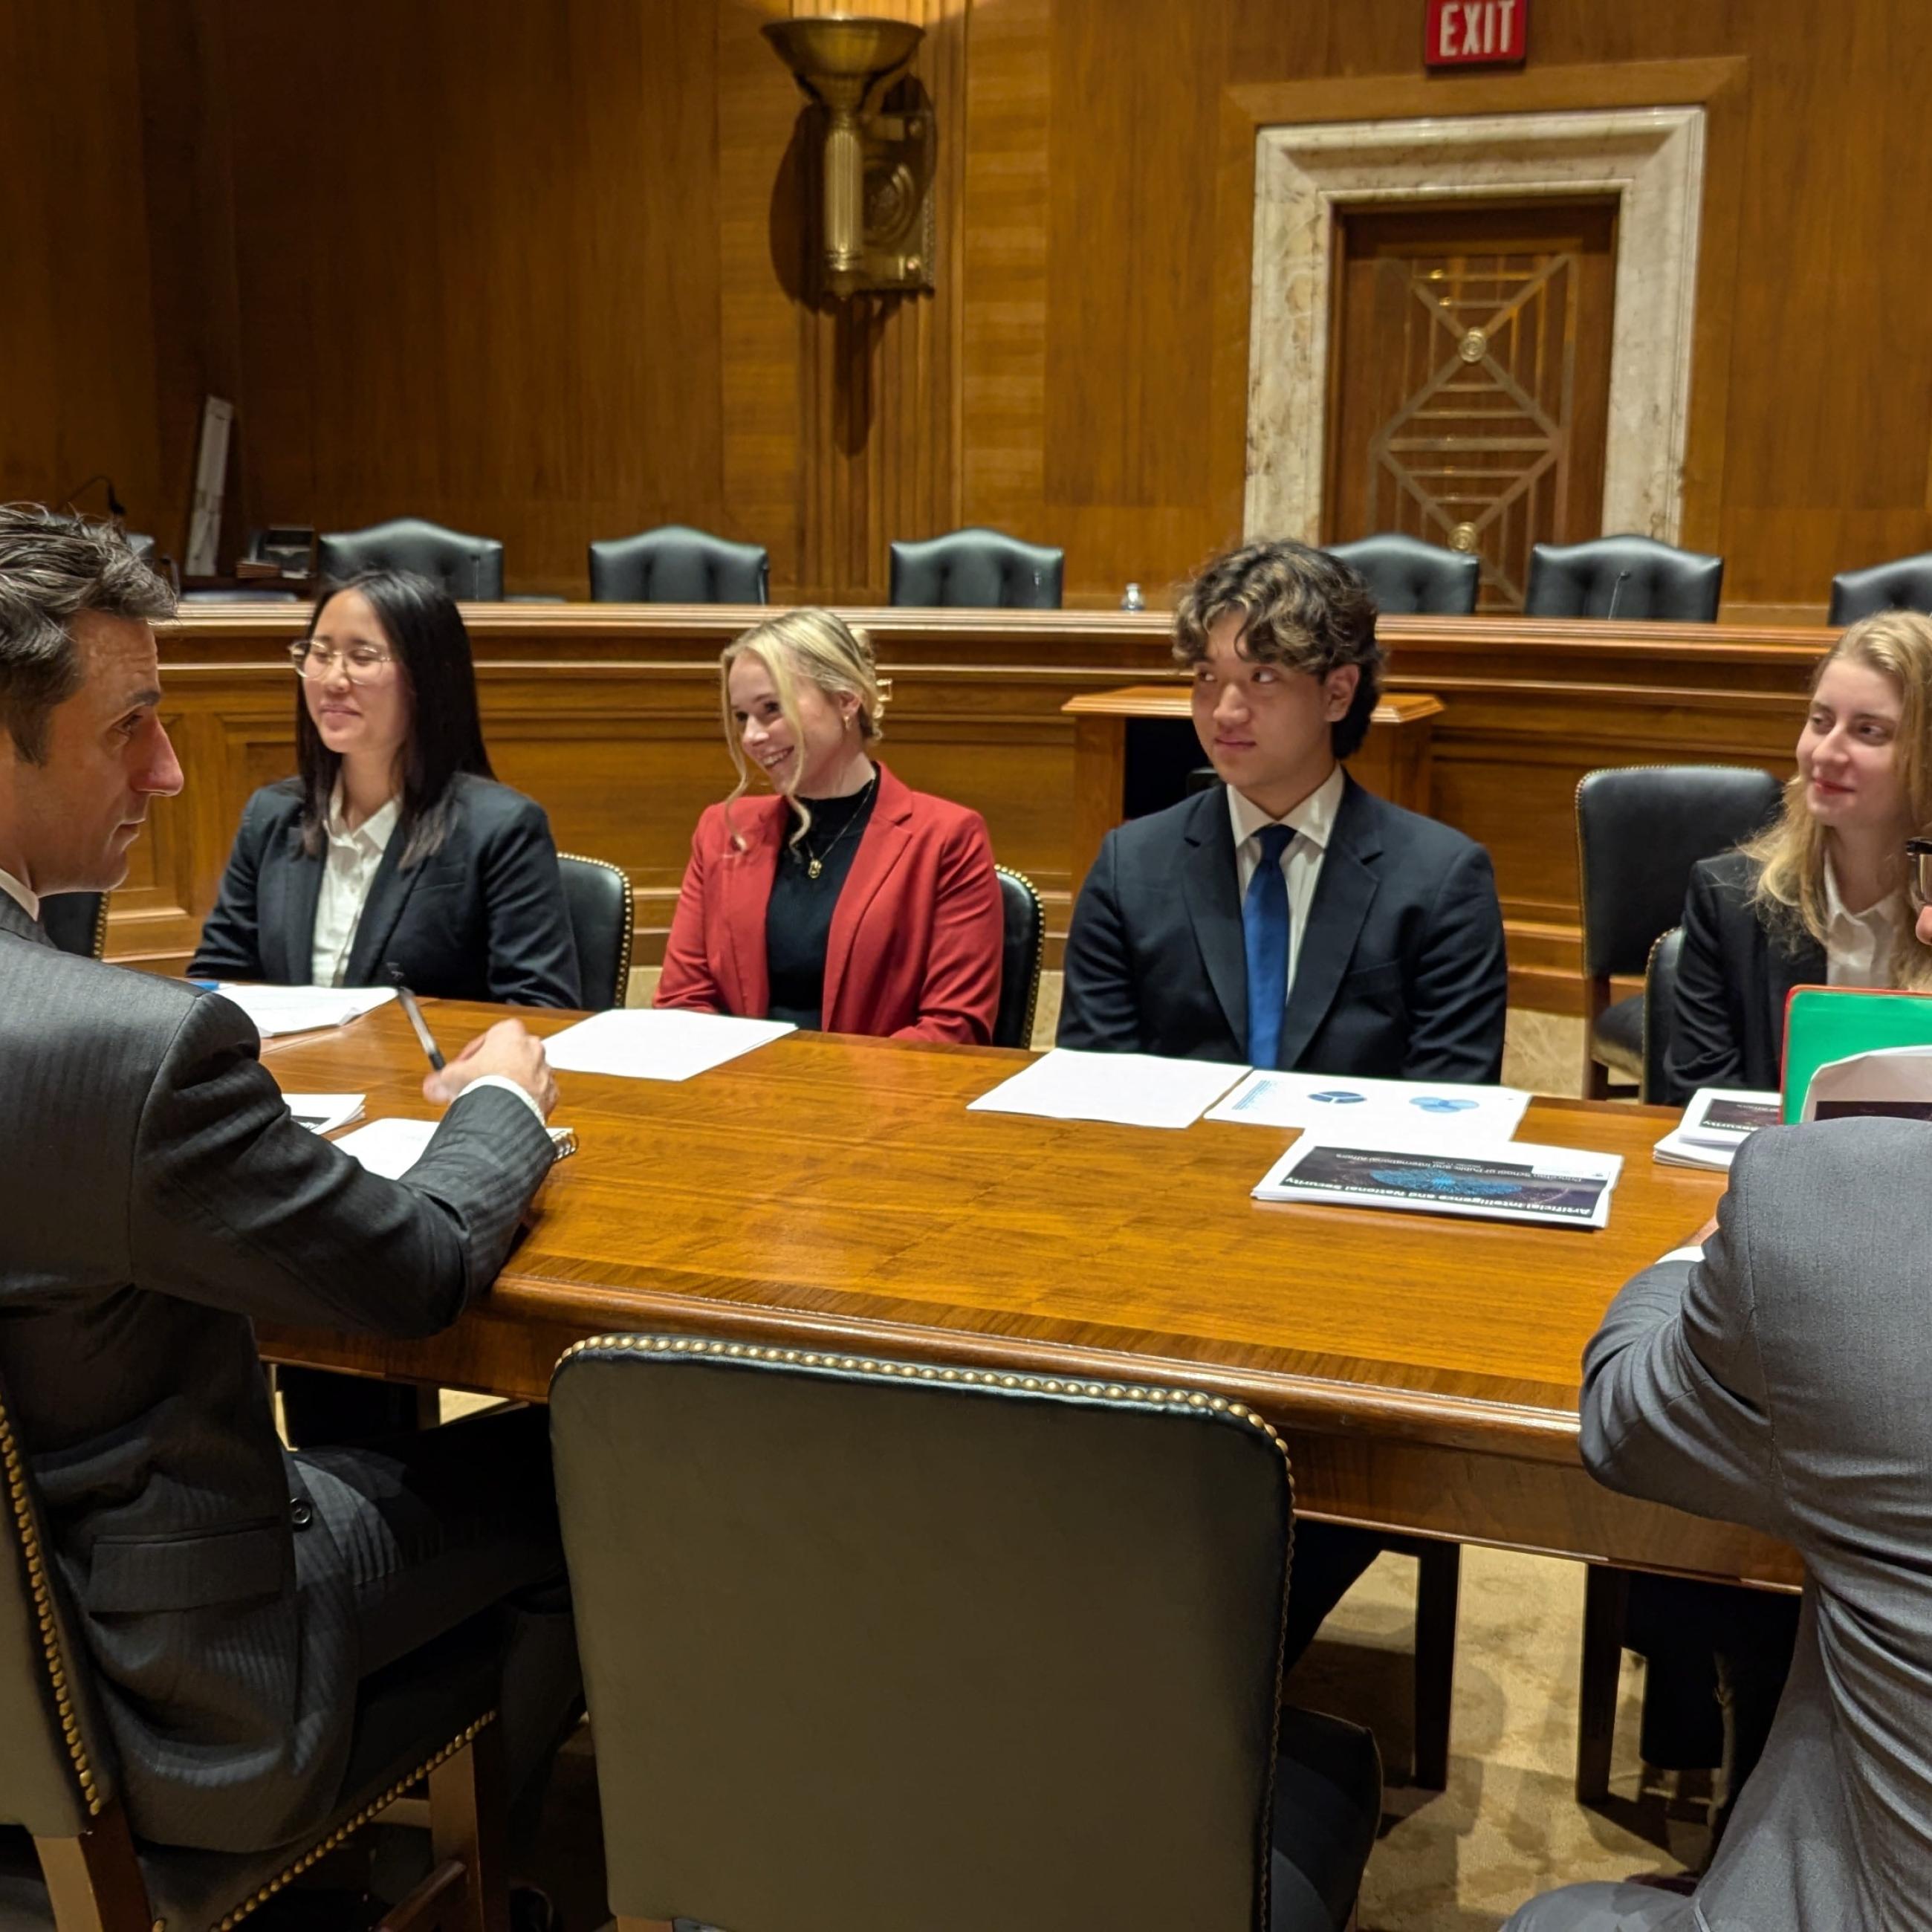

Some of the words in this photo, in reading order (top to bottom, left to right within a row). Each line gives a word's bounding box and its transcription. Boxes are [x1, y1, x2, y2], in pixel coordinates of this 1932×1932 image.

[1439, 1, 1515, 56] EXIT
[1369, 1156, 1430, 1168] International
[1285, 1176, 1341, 1190] Security
[1344, 1185, 1405, 1196] National
[1407, 1191, 1436, 1199] and
[1438, 1194, 1524, 1209] Intelligence
[1526, 1202, 1591, 1215] Artificial
